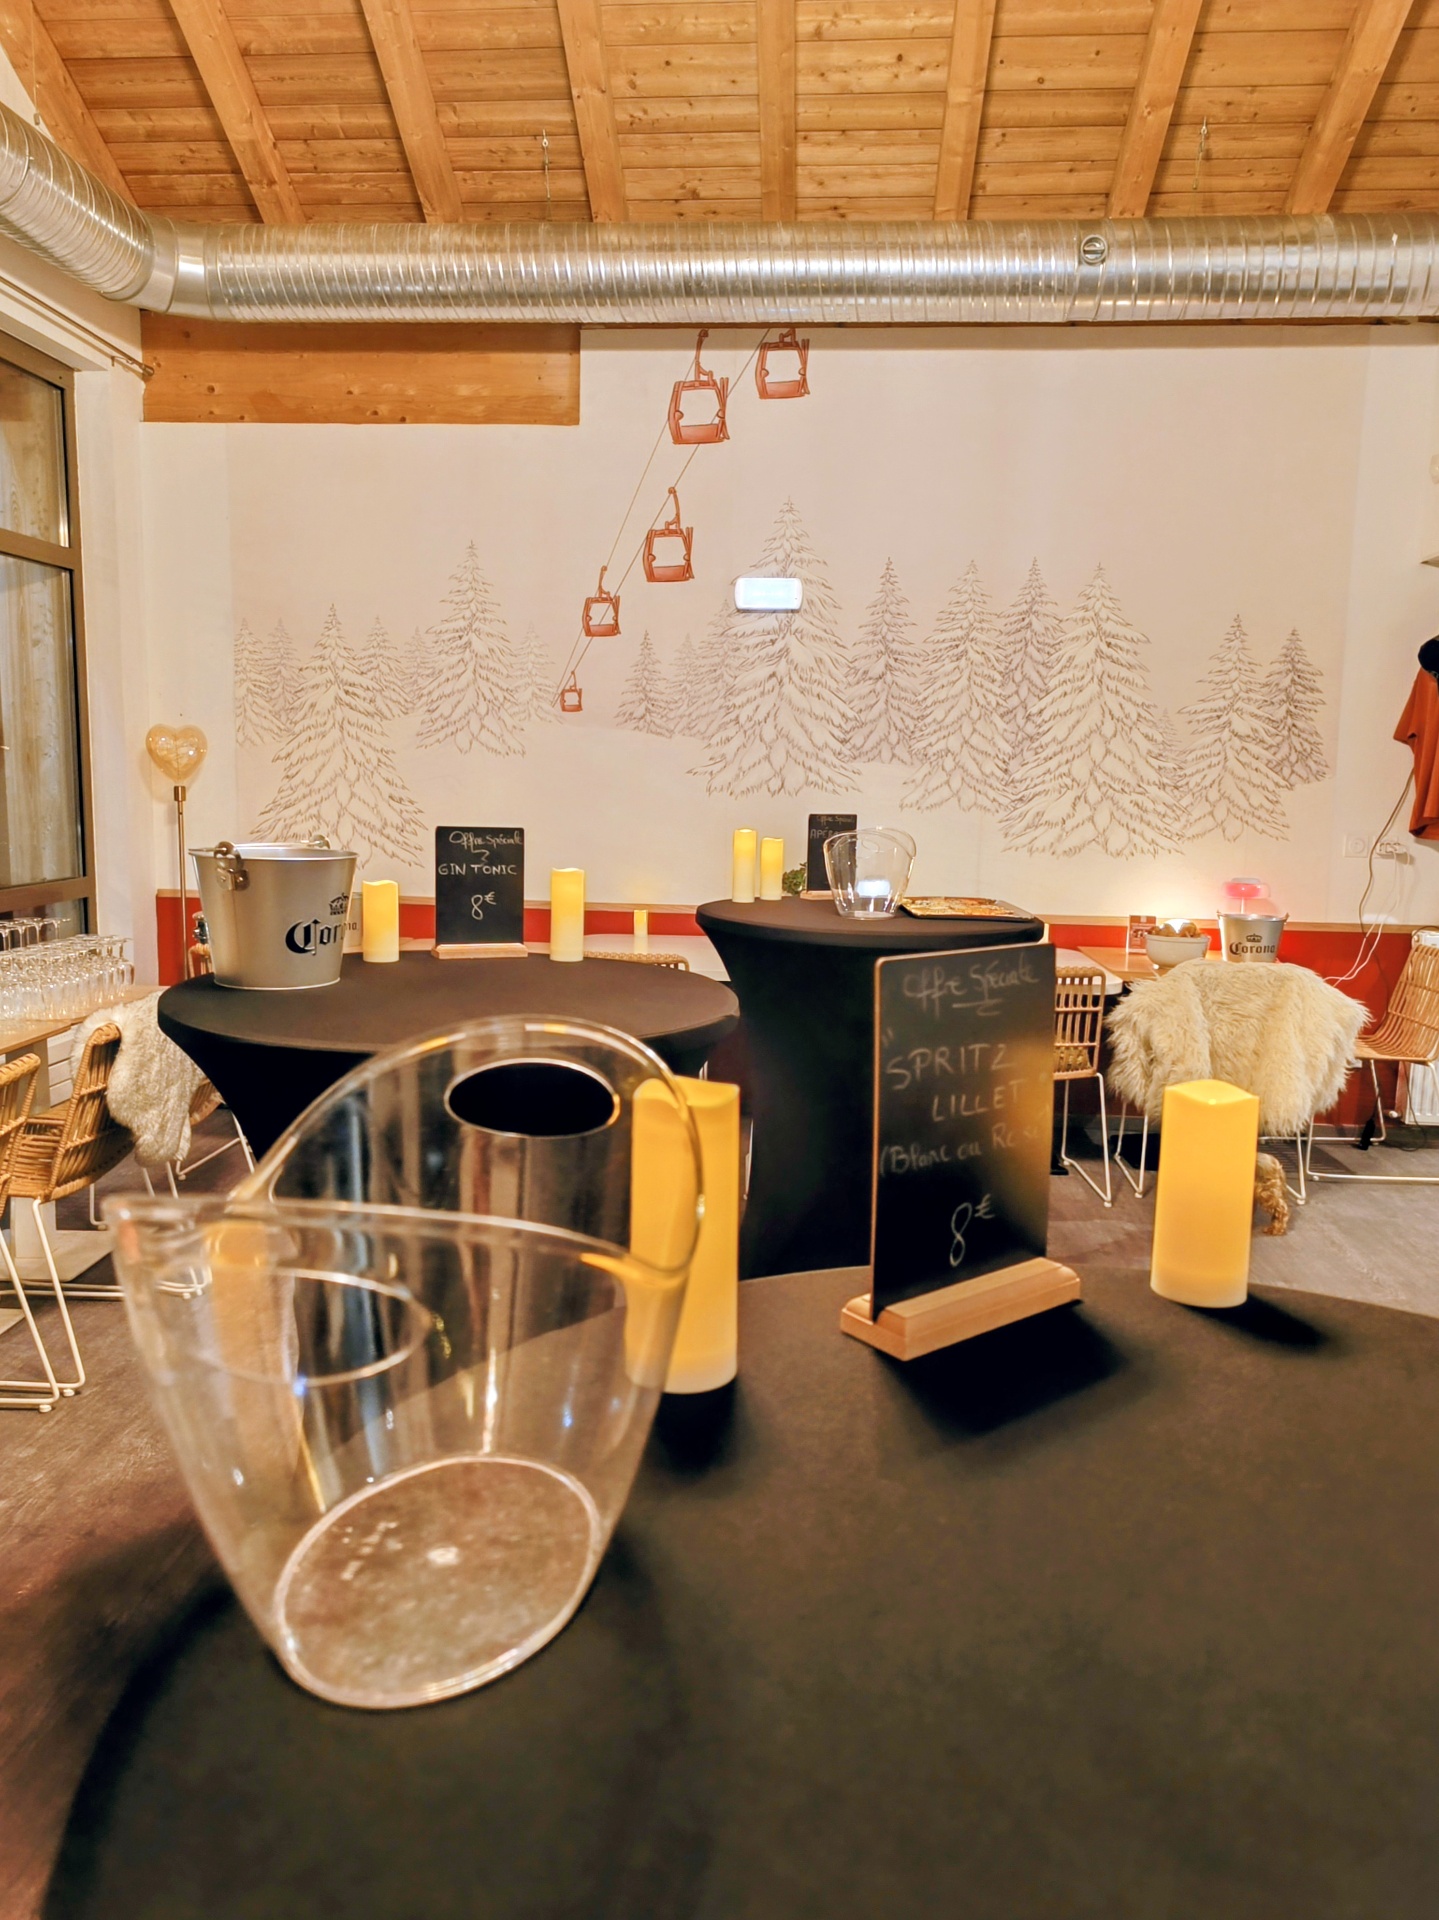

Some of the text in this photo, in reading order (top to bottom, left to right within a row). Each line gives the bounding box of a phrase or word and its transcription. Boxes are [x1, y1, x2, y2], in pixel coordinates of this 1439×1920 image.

[449, 830, 485, 850] Offre
[438, 863, 518, 876] GIN TONIC
[470, 891, 497, 920] 8€
[285, 918, 345, 957] Cor
[1229, 941, 1276, 957] Corona
[932, 1079, 1027, 1122] LILLET
[950, 1193, 995, 1268] 8€
